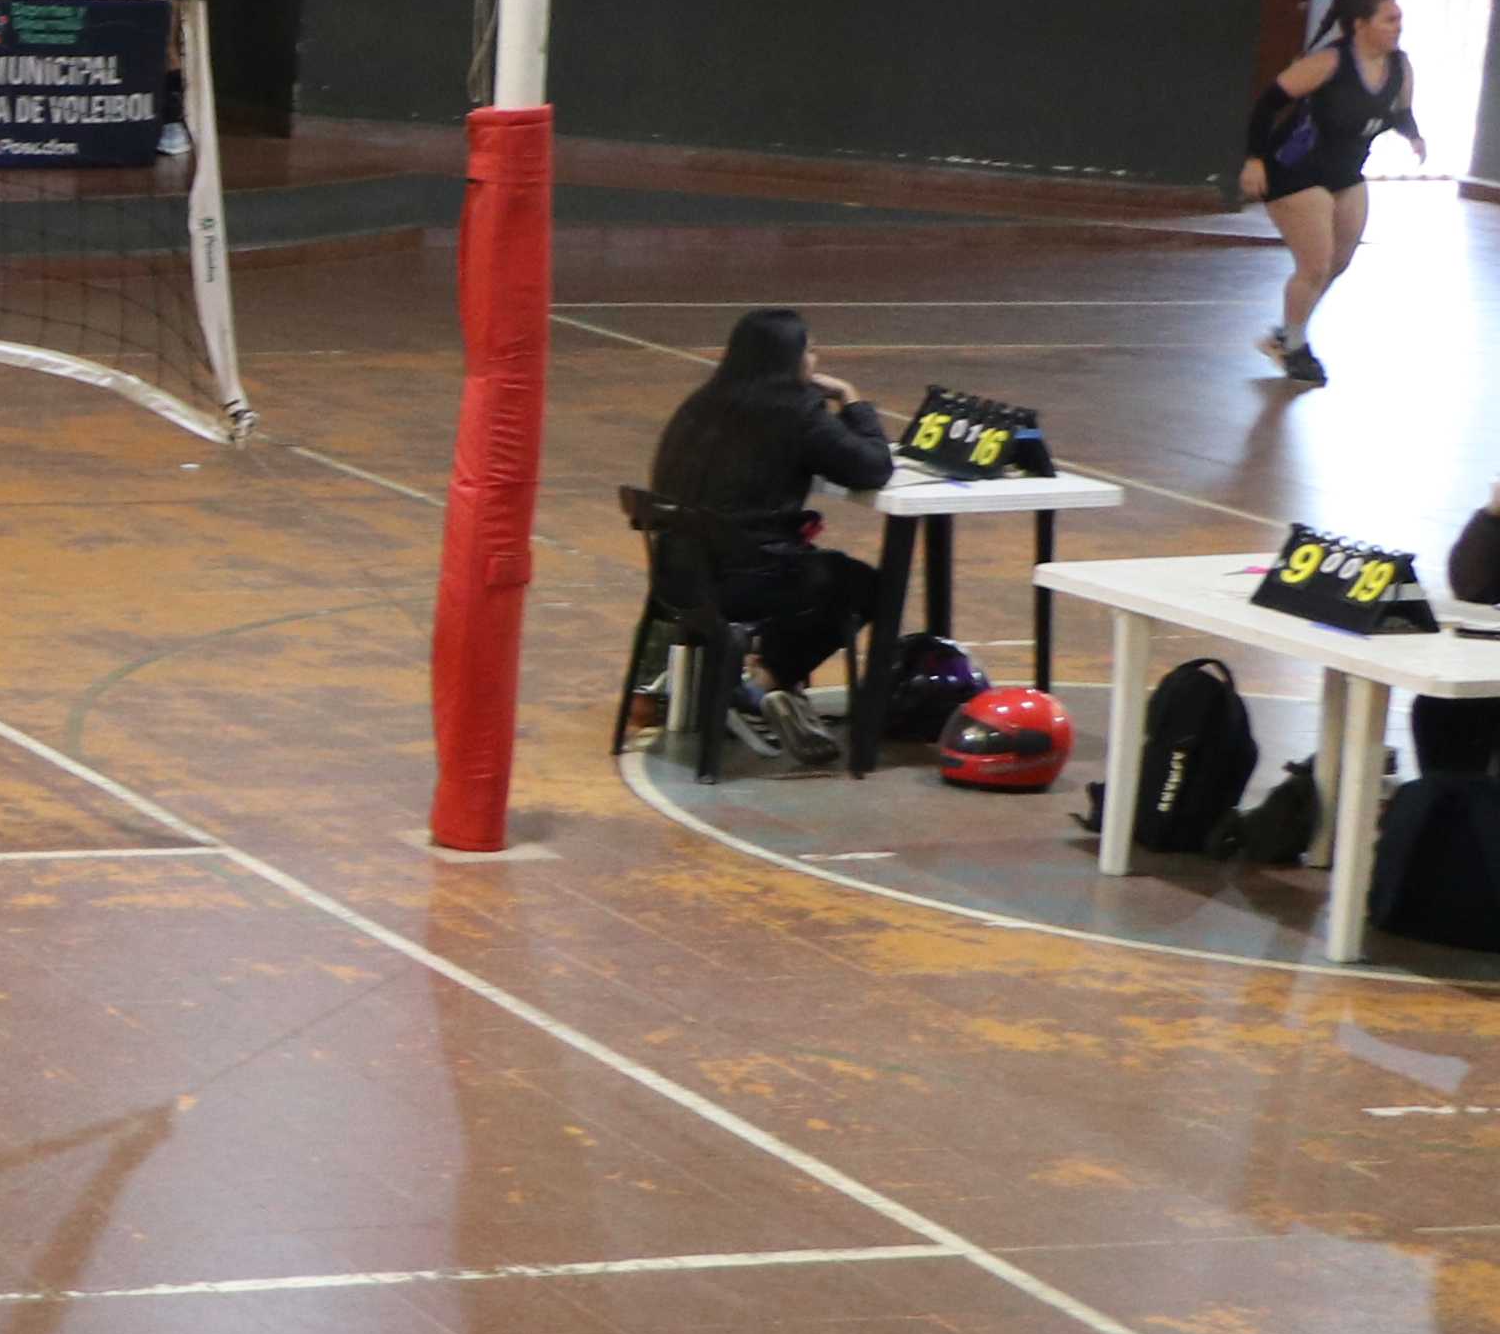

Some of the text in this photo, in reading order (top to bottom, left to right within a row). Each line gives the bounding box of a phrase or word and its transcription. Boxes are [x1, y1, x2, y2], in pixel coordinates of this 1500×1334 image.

[15, 95, 46, 125] DE
[49, 92, 156, 124] VOLEIBOL
[1279, 543, 1325, 584] 9
[1346, 560, 1396, 603] 19
